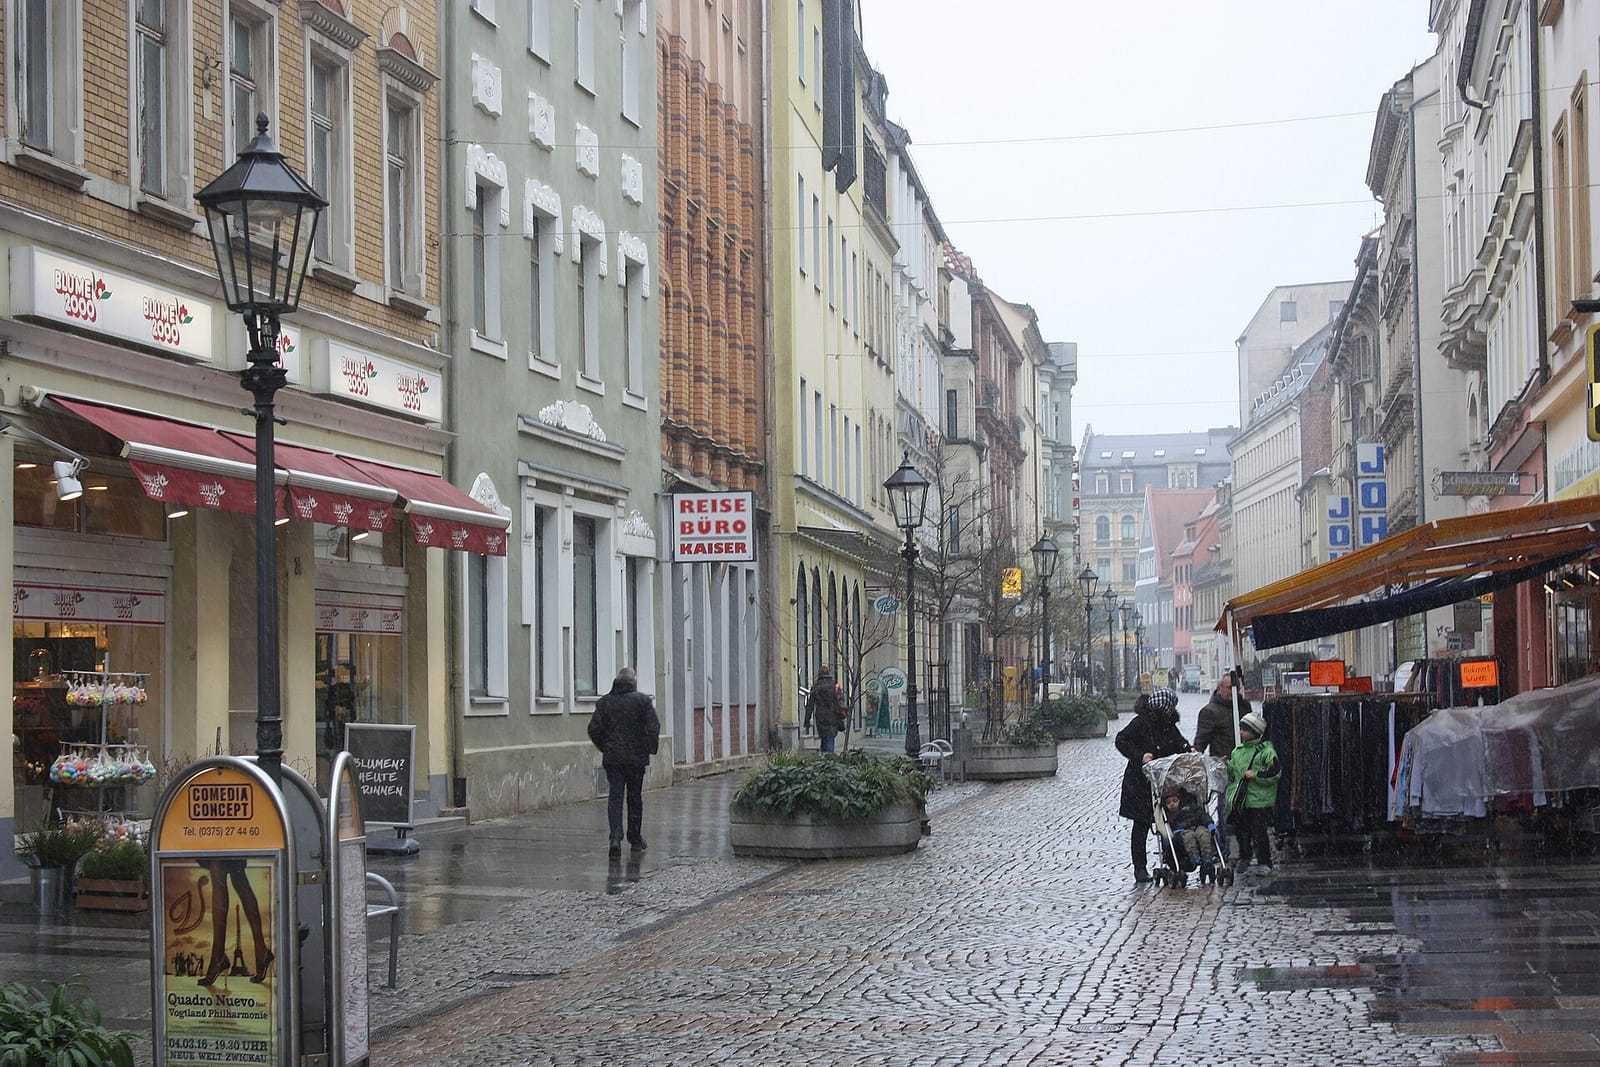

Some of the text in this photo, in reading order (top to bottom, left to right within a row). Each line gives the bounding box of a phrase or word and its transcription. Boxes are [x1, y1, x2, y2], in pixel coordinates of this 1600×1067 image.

[55, 269, 95, 299] BLUME
[64, 293, 97, 323] 2000
[143, 297, 177, 324] BLUME
[152, 319, 180, 346] 2000
[680, 498, 746, 514] REISE
[680, 516, 746, 535] BÜRO
[679, 542, 747, 555] KAISER
[358, 771, 398, 783] HEUTE
[193, 787, 249, 801] COMEDIA
[193, 803, 249, 817] CONCEPT
[183, 826, 260, 838] Tel. (0375) 27 44 60
[168, 993, 213, 1008] Quadro
[215, 994, 255, 1008] Nuevo
[169, 1008, 269, 1020] Vogtland Philharmonie
[242, 1041, 268, 1052] UHR
[169, 1051, 268, 1064] NEUE WELT ZWICKAU
